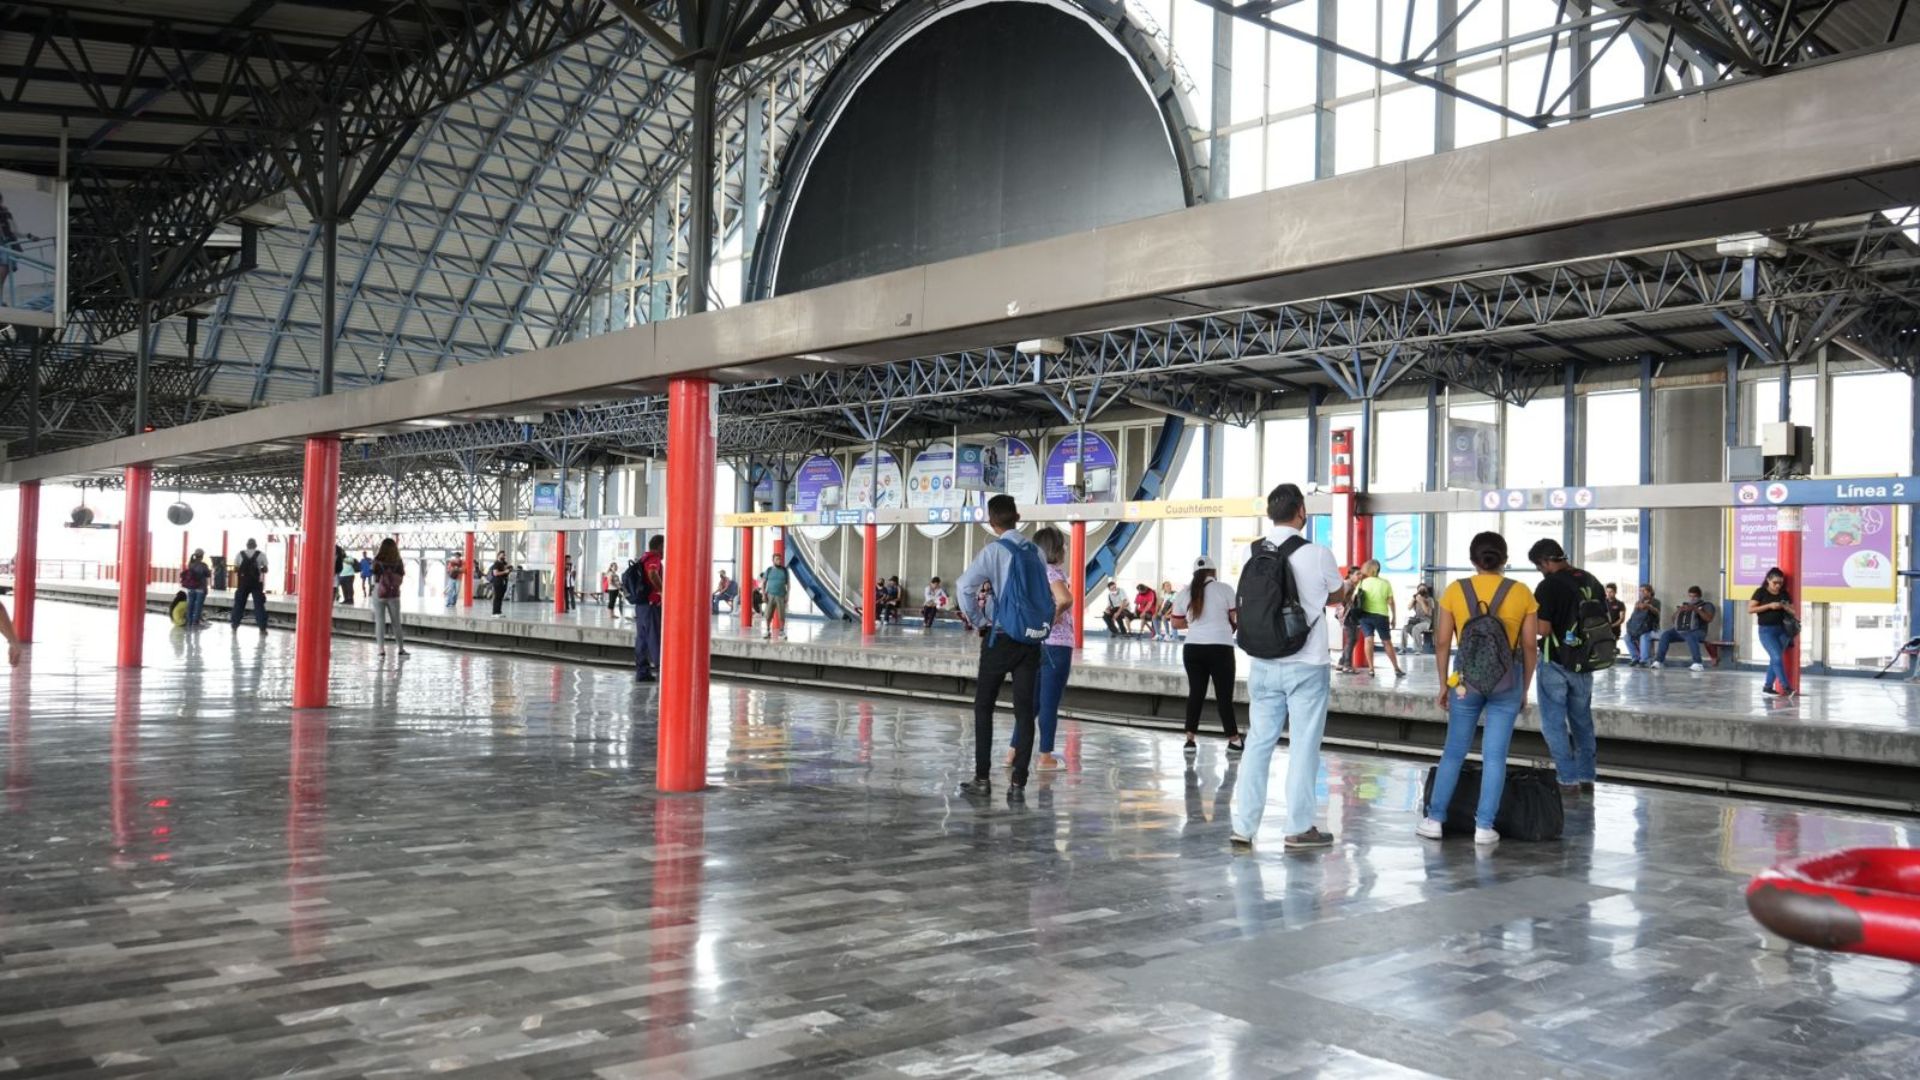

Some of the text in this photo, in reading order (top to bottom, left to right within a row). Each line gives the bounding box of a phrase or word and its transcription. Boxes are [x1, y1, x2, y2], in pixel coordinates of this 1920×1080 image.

[1837, 483, 1905, 498] Línea 2
[1165, 502, 1224, 514] Cuauhtémoc
